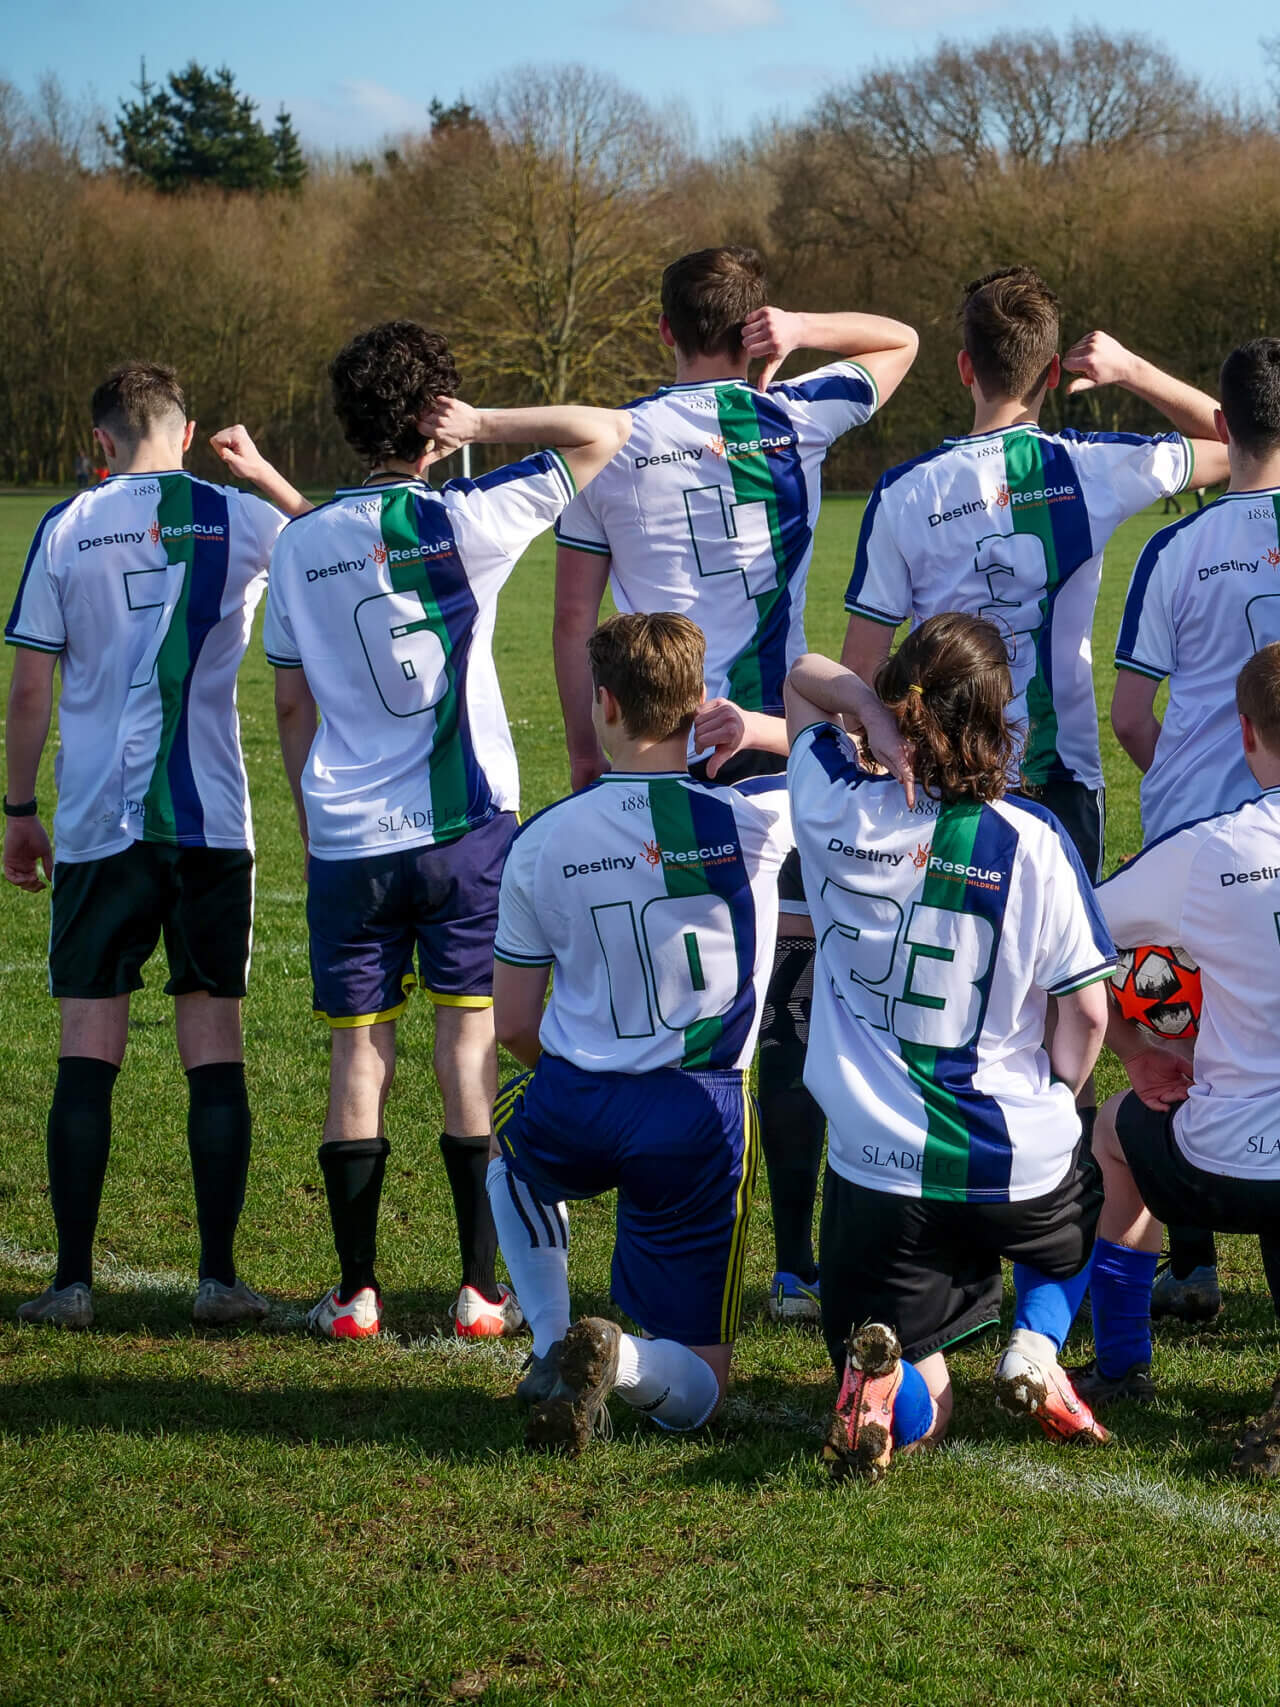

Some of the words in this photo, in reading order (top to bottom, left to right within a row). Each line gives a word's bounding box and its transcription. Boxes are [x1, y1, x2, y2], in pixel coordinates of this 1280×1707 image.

[635, 447, 703, 470] Destiny
[726, 435, 791, 454] Rescue
[928, 497, 989, 528] Destiny
[1011, 486, 1075, 504] Rescue
[78, 527, 145, 552] Destiny
[161, 524, 224, 538] Rescue
[683, 485, 779, 600] 4
[306, 558, 367, 582] Destiny
[389, 541, 450, 562] Rescue
[1198, 560, 1260, 582] Destiny
[123, 561, 187, 689] 7
[354, 589, 450, 718] 6
[378, 810, 436, 832] SLADE
[563, 855, 636, 879] Destiny
[661, 844, 735, 863] Rescue
[827, 838, 905, 868] Destiny
[929, 856, 1001, 882] Rescue
[964, 878, 1001, 891] CHILDREN
[590, 893, 739, 1039] 10
[820, 877, 997, 1049] 23
[862, 1145, 927, 1171] SLADE
[935, 1157, 963, 1176] FC
